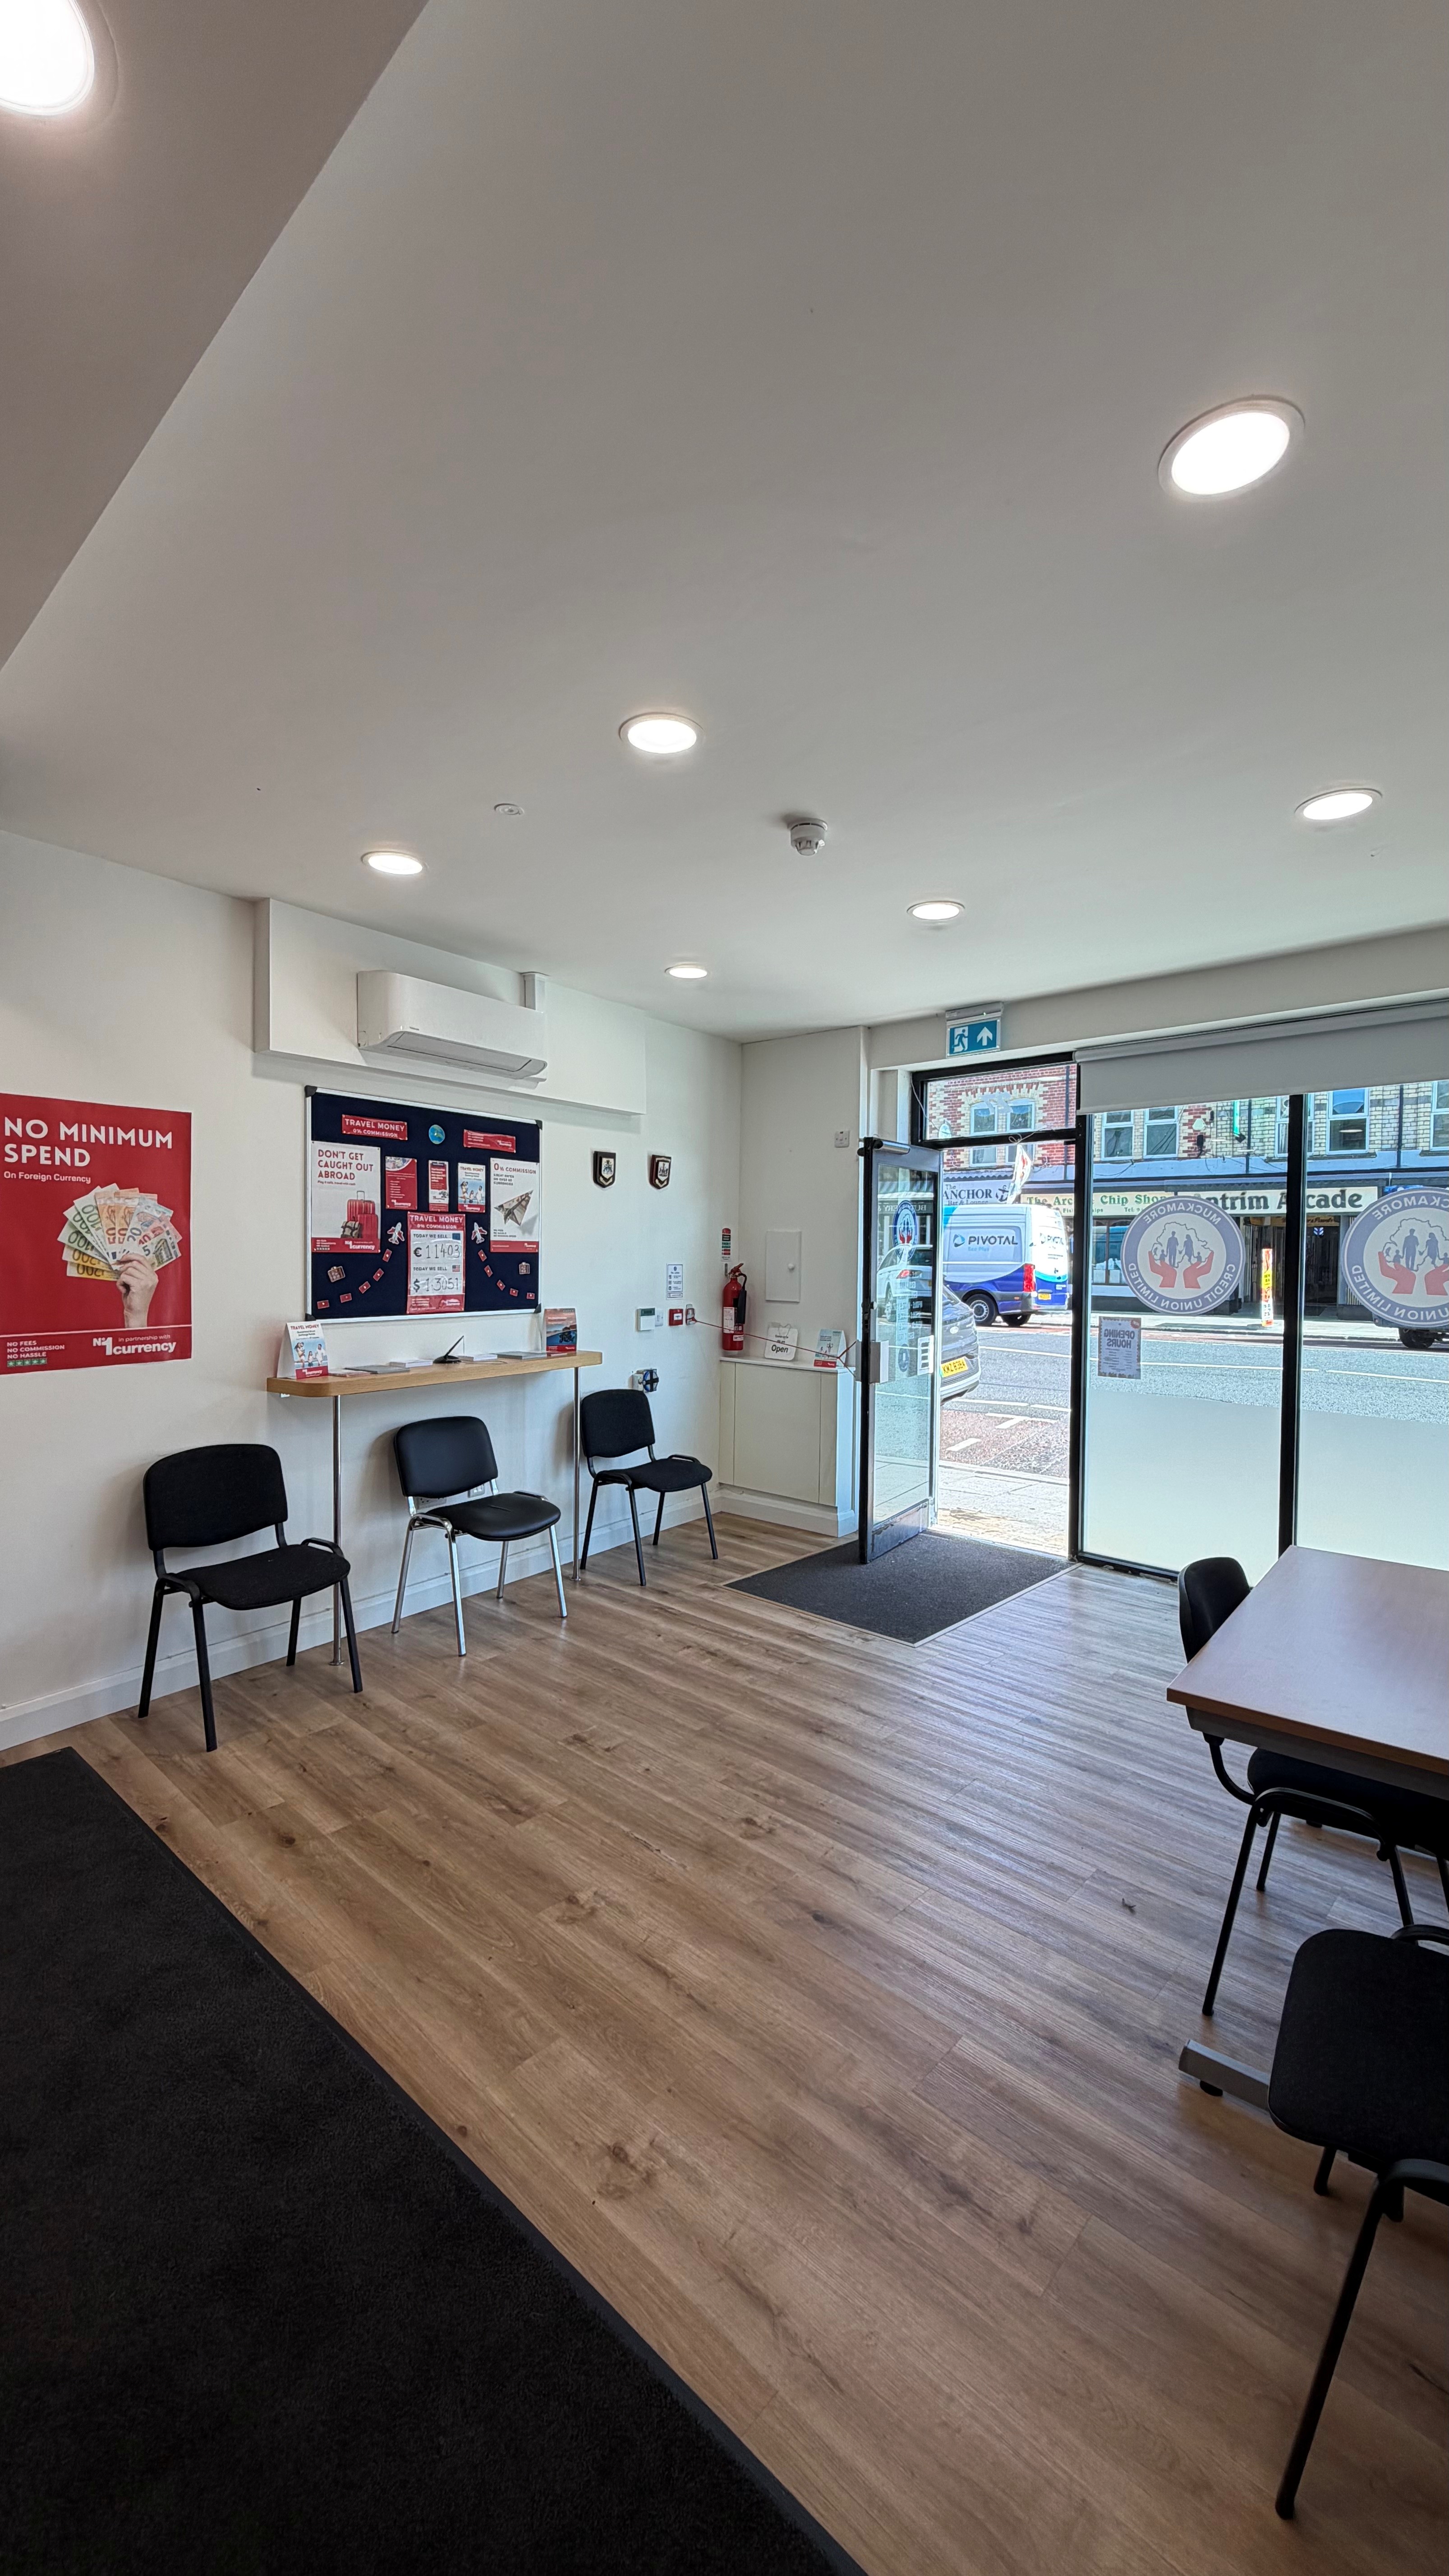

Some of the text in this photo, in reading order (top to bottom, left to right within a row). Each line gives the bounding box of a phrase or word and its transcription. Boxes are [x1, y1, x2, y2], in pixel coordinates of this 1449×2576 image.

[345, 1118, 405, 1132] TRAVEL MONEY
[5, 1117, 172, 1149] NO MINIMUM
[363, 1129, 398, 1137] COMMISSION
[4, 1144, 90, 1167] SPEND
[318, 1149, 364, 1160] DON'T GET
[318, 1160, 373, 1172] CAUGHT OUT
[19, 1172, 51, 1182] Foreign
[54, 1173, 91, 1184] Currency
[318, 1170, 355, 1180] ABROAD
[943, 1189, 993, 1200] ANCHOR
[1100, 1195, 1129, 1206] Chip
[1195, 1189, 1362, 1210] ntrim Acade
[968, 1236, 1018, 1245] PIVOTAL
[413, 1279, 420, 1293] $
[113, 1342, 176, 1355] currency
[772, 1344, 788, 1353] Open
